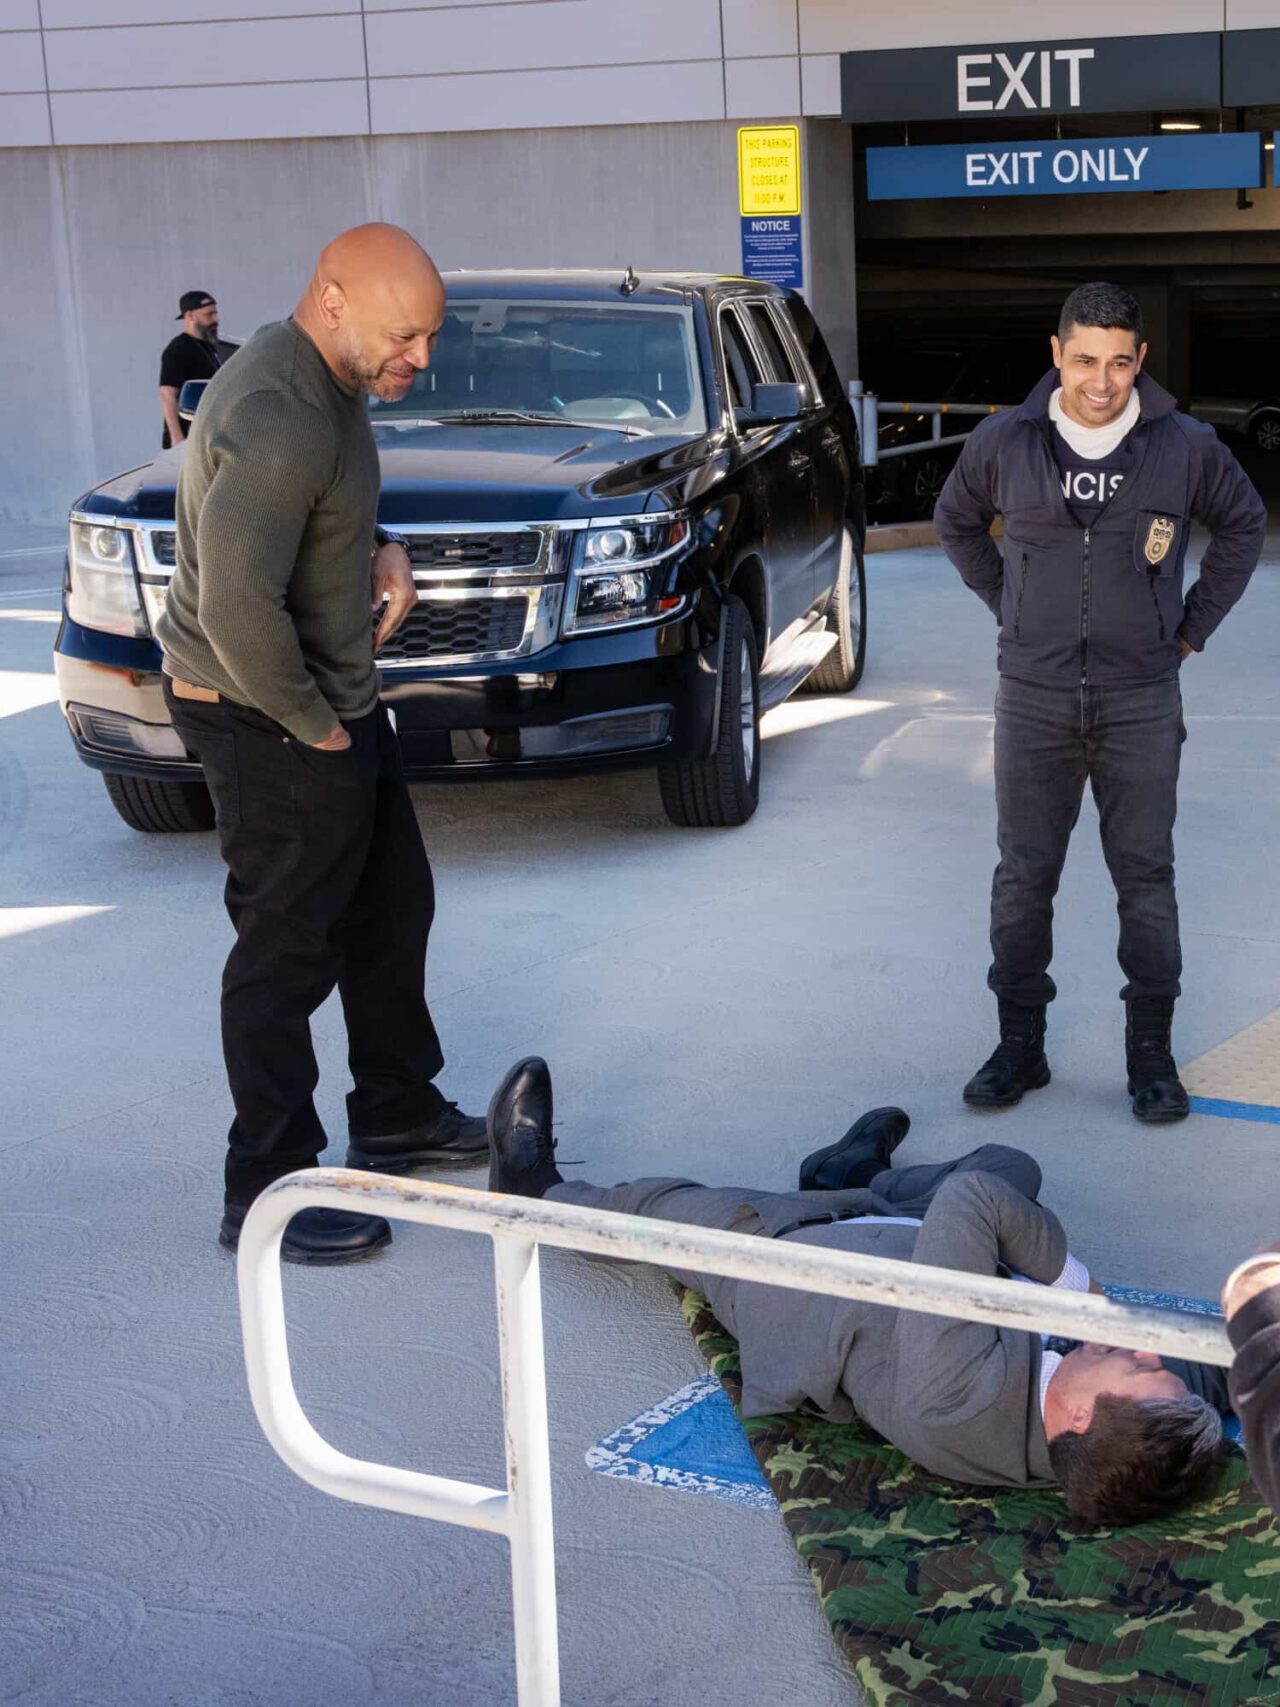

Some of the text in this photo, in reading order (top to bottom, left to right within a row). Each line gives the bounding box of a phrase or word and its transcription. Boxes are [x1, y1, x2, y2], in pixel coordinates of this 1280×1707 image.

[957, 48, 1095, 112] EXIT
[762, 138, 793, 149] PARKING
[750, 156, 789, 168] STRUCTURE
[966, 147, 1149, 186] EXIT ONLY
[751, 220, 791, 232] NOTICE
